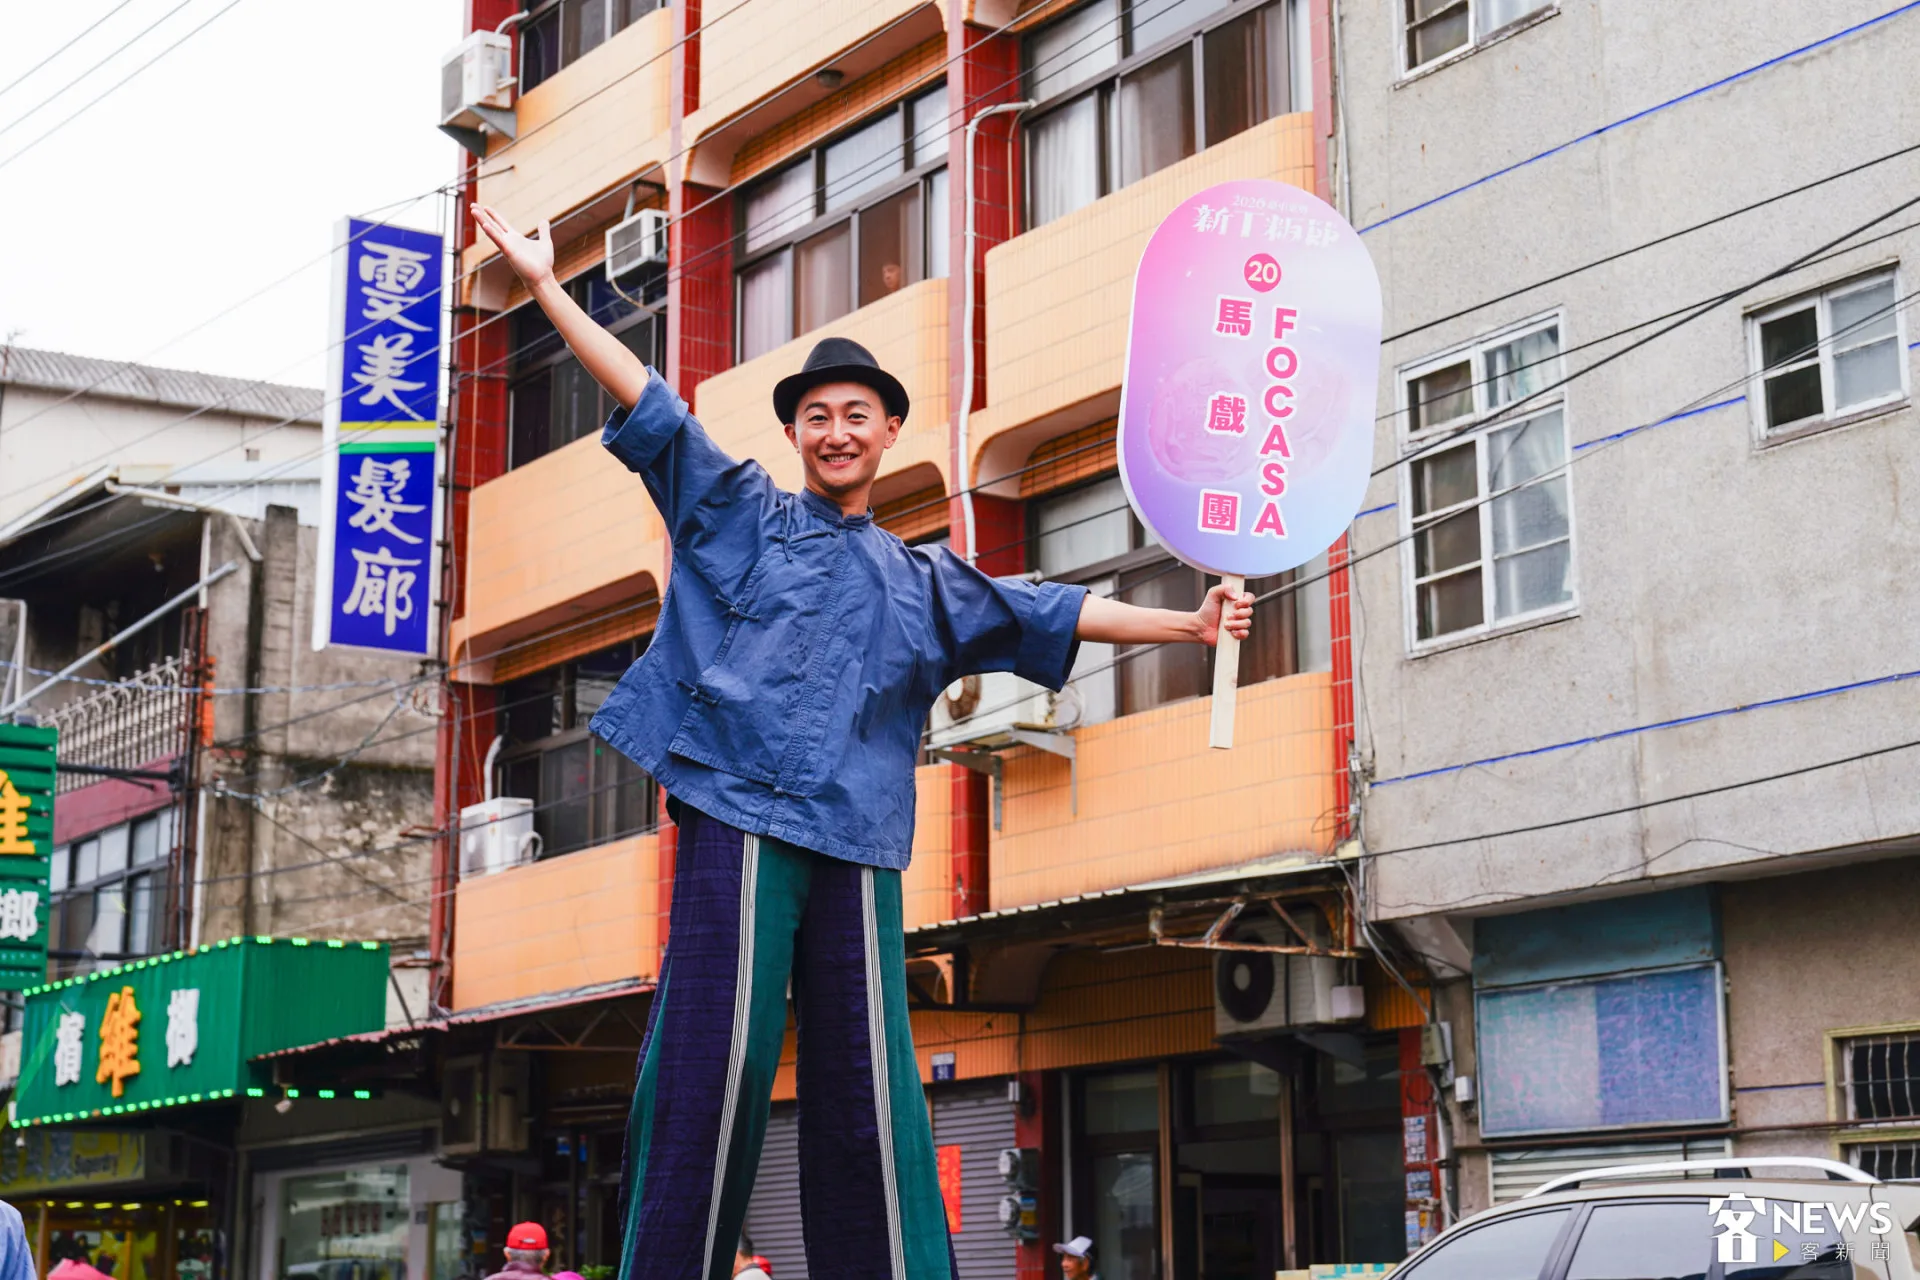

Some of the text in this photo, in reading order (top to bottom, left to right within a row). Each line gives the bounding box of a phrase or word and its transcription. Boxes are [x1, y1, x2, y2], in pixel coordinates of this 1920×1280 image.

[1231, 194, 1266, 209] 2026
[1247, 260, 1279, 284] 20
[1201, 297, 1254, 532] 馬戲團
[1254, 307, 1299, 537] FOCASA
